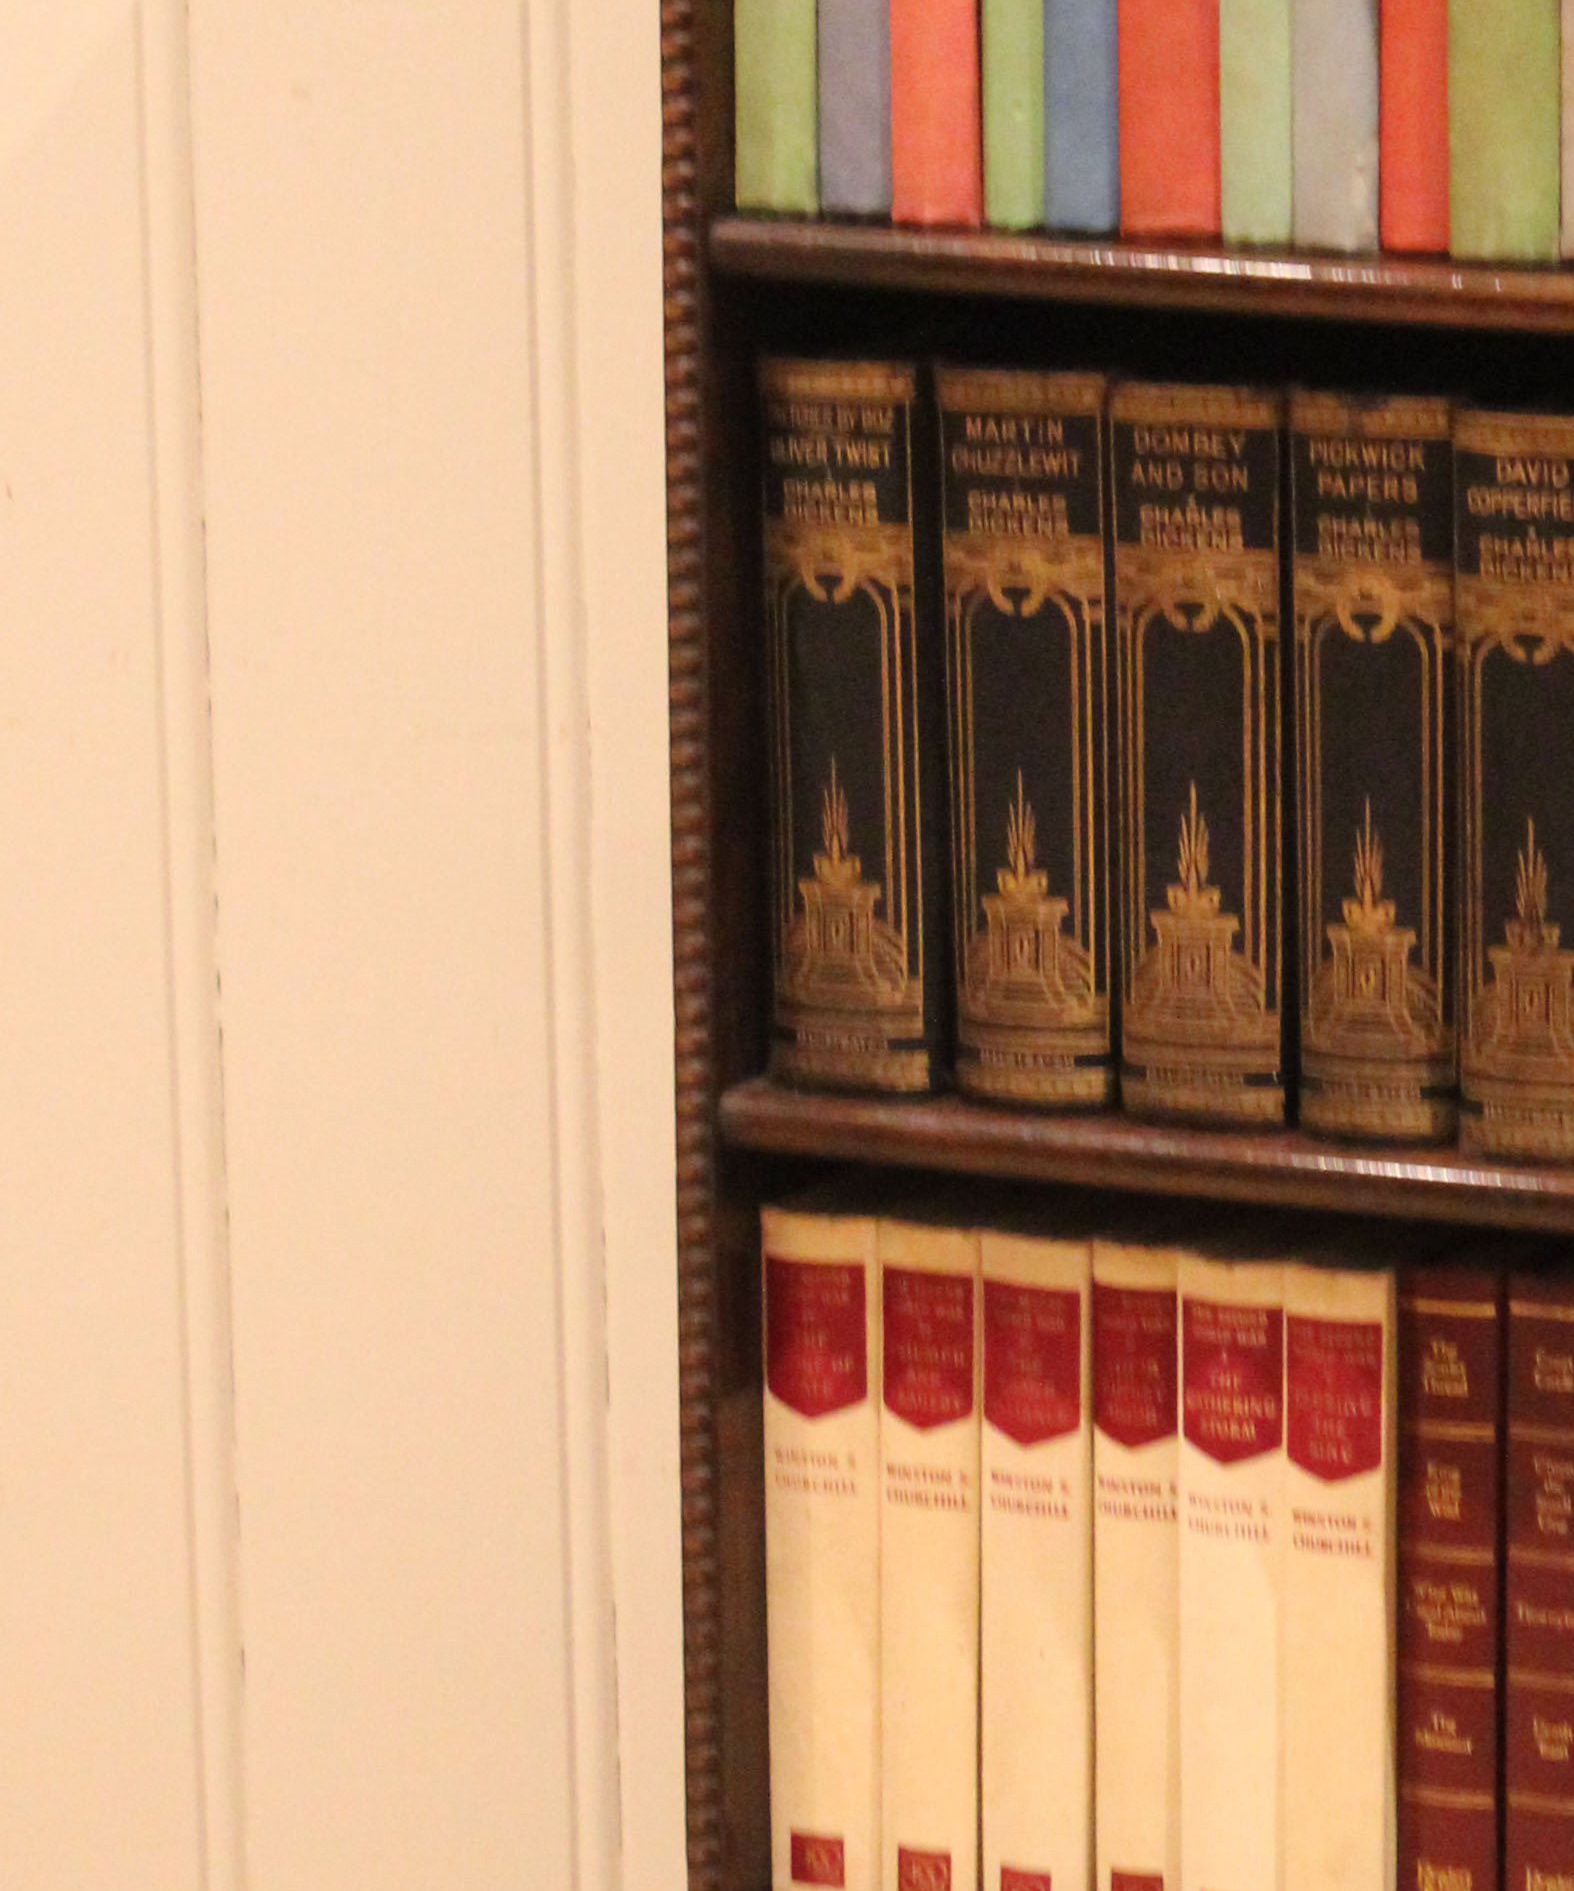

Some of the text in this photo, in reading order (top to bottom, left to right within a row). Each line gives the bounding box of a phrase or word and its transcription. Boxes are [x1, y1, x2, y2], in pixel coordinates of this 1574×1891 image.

[965, 416, 1064, 444] MARTIN
[1133, 427, 1246, 457] DOMBEY
[1309, 438, 1425, 470] PICKWICK
[1131, 462, 1249, 492] AND SON
[1496, 455, 1570, 489] DAVID
[783, 479, 877, 501] CHARLES
[1317, 470, 1419, 504] PAPERS
[783, 501, 879, 526] DICKENS
[967, 490, 1068, 512] CHARLES
[968, 512, 1070, 537] DICKENS
[1139, 504, 1242, 528] CHARLES
[1317, 513, 1421, 538] CHARLES
[1140, 527, 1245, 552] DICKENS
[1318, 537, 1423, 563] DICKENS
[885, 1462, 953, 1486] WINSTON
[989, 1468, 1054, 1494] WINSTON
[1097, 1474, 1162, 1498] WINSTON
[885, 1485, 969, 1512] CHURCHILL
[989, 1493, 1070, 1521] CHURCHILL
[1097, 1499, 1178, 1523] CHURCHILL
[1292, 1507, 1358, 1533] WINSTON
[1292, 1530, 1373, 1559] CHURCHILL
